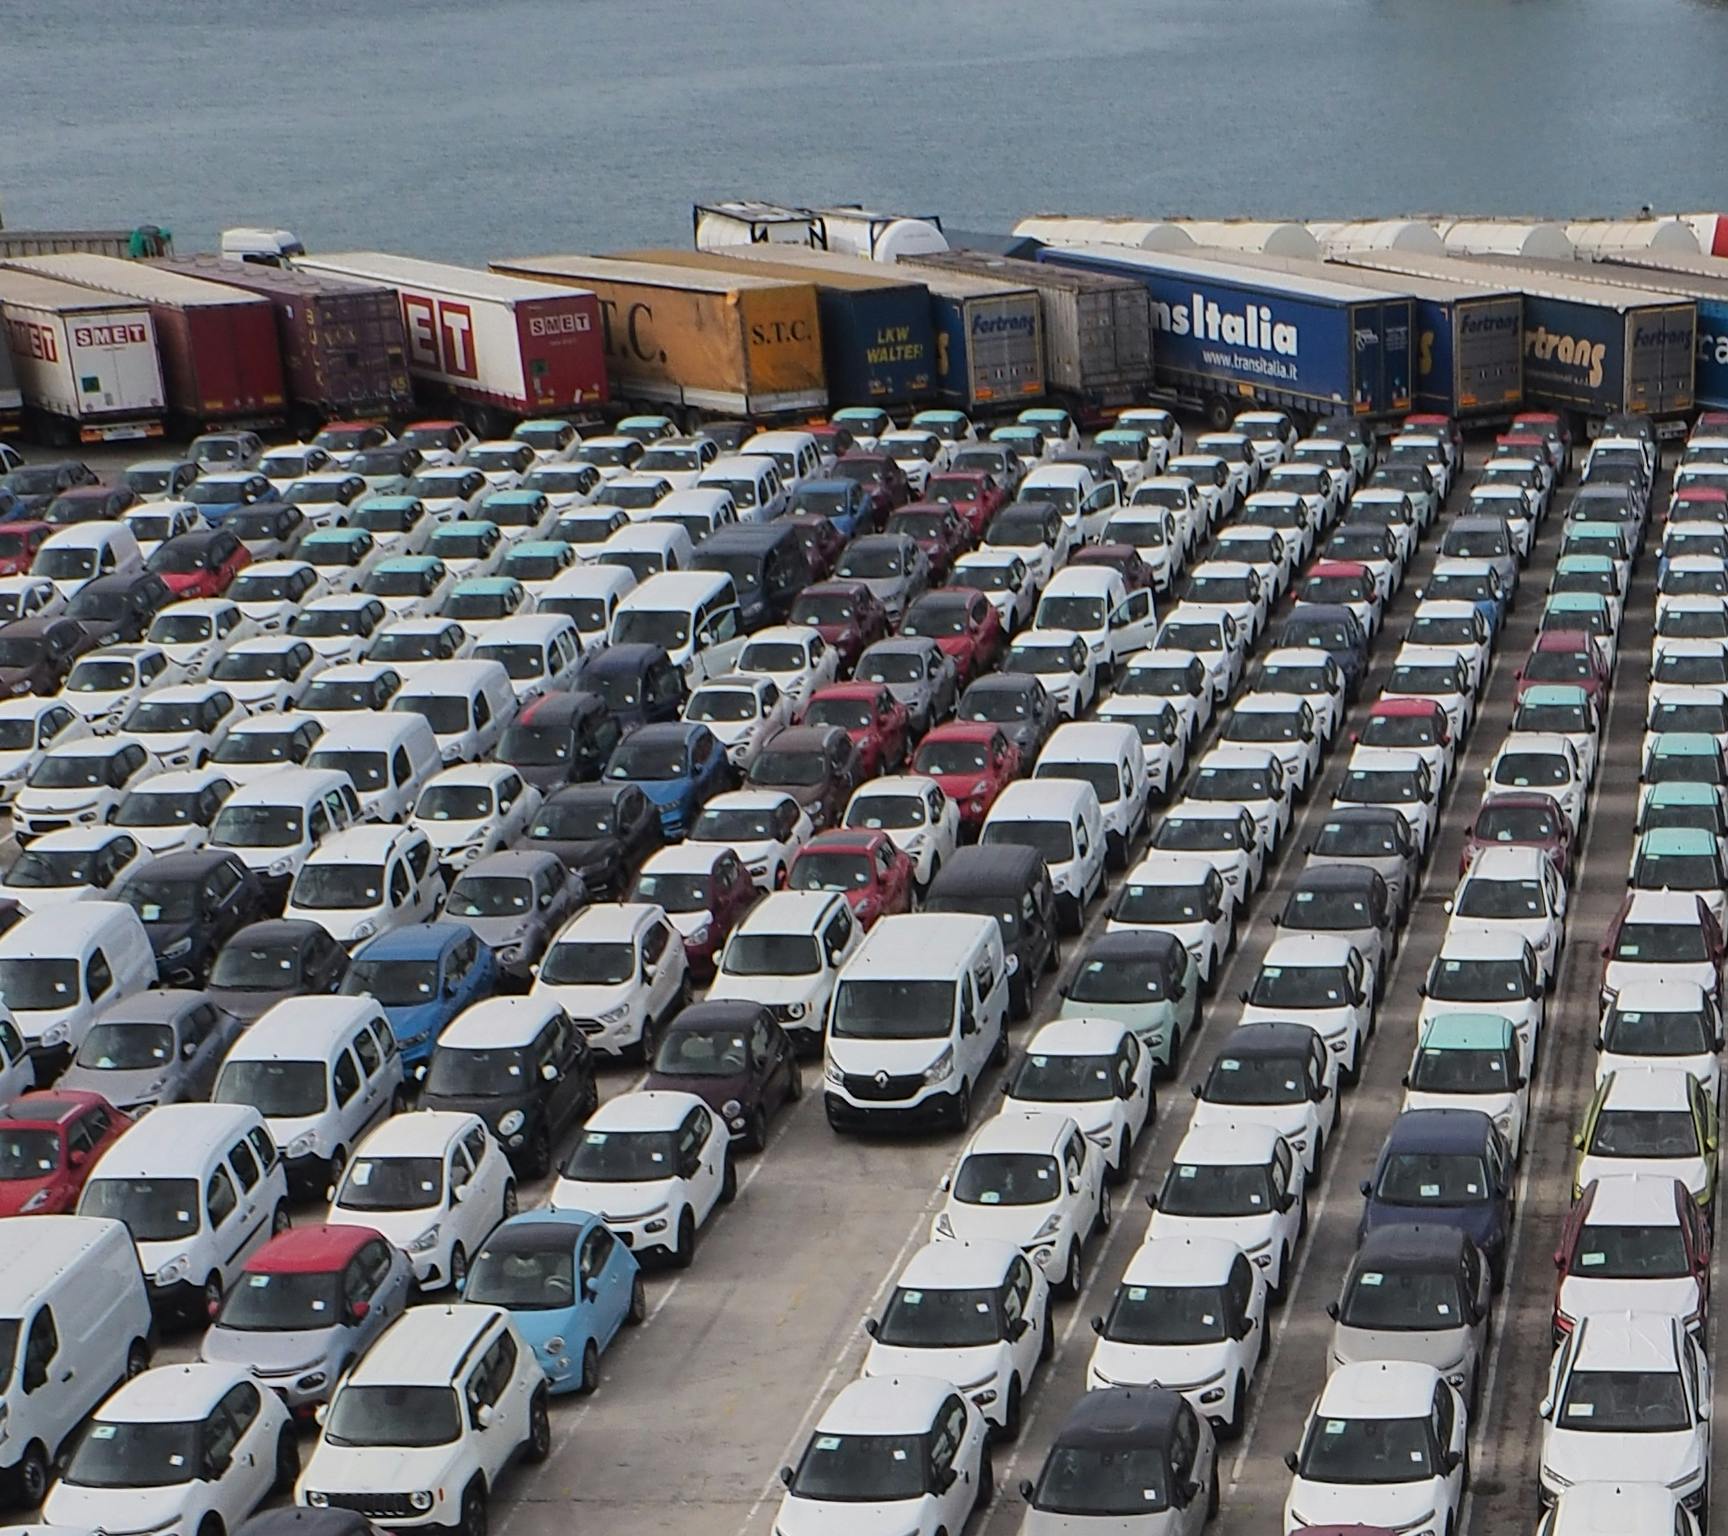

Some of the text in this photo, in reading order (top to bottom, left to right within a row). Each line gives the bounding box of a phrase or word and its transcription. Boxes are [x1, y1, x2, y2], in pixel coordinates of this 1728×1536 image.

[530, 313, 590, 336] SMET
[752, 320, 813, 346] S.T.C.
[877, 326, 911, 344] LKW
[76, 325, 146, 347] SMET
